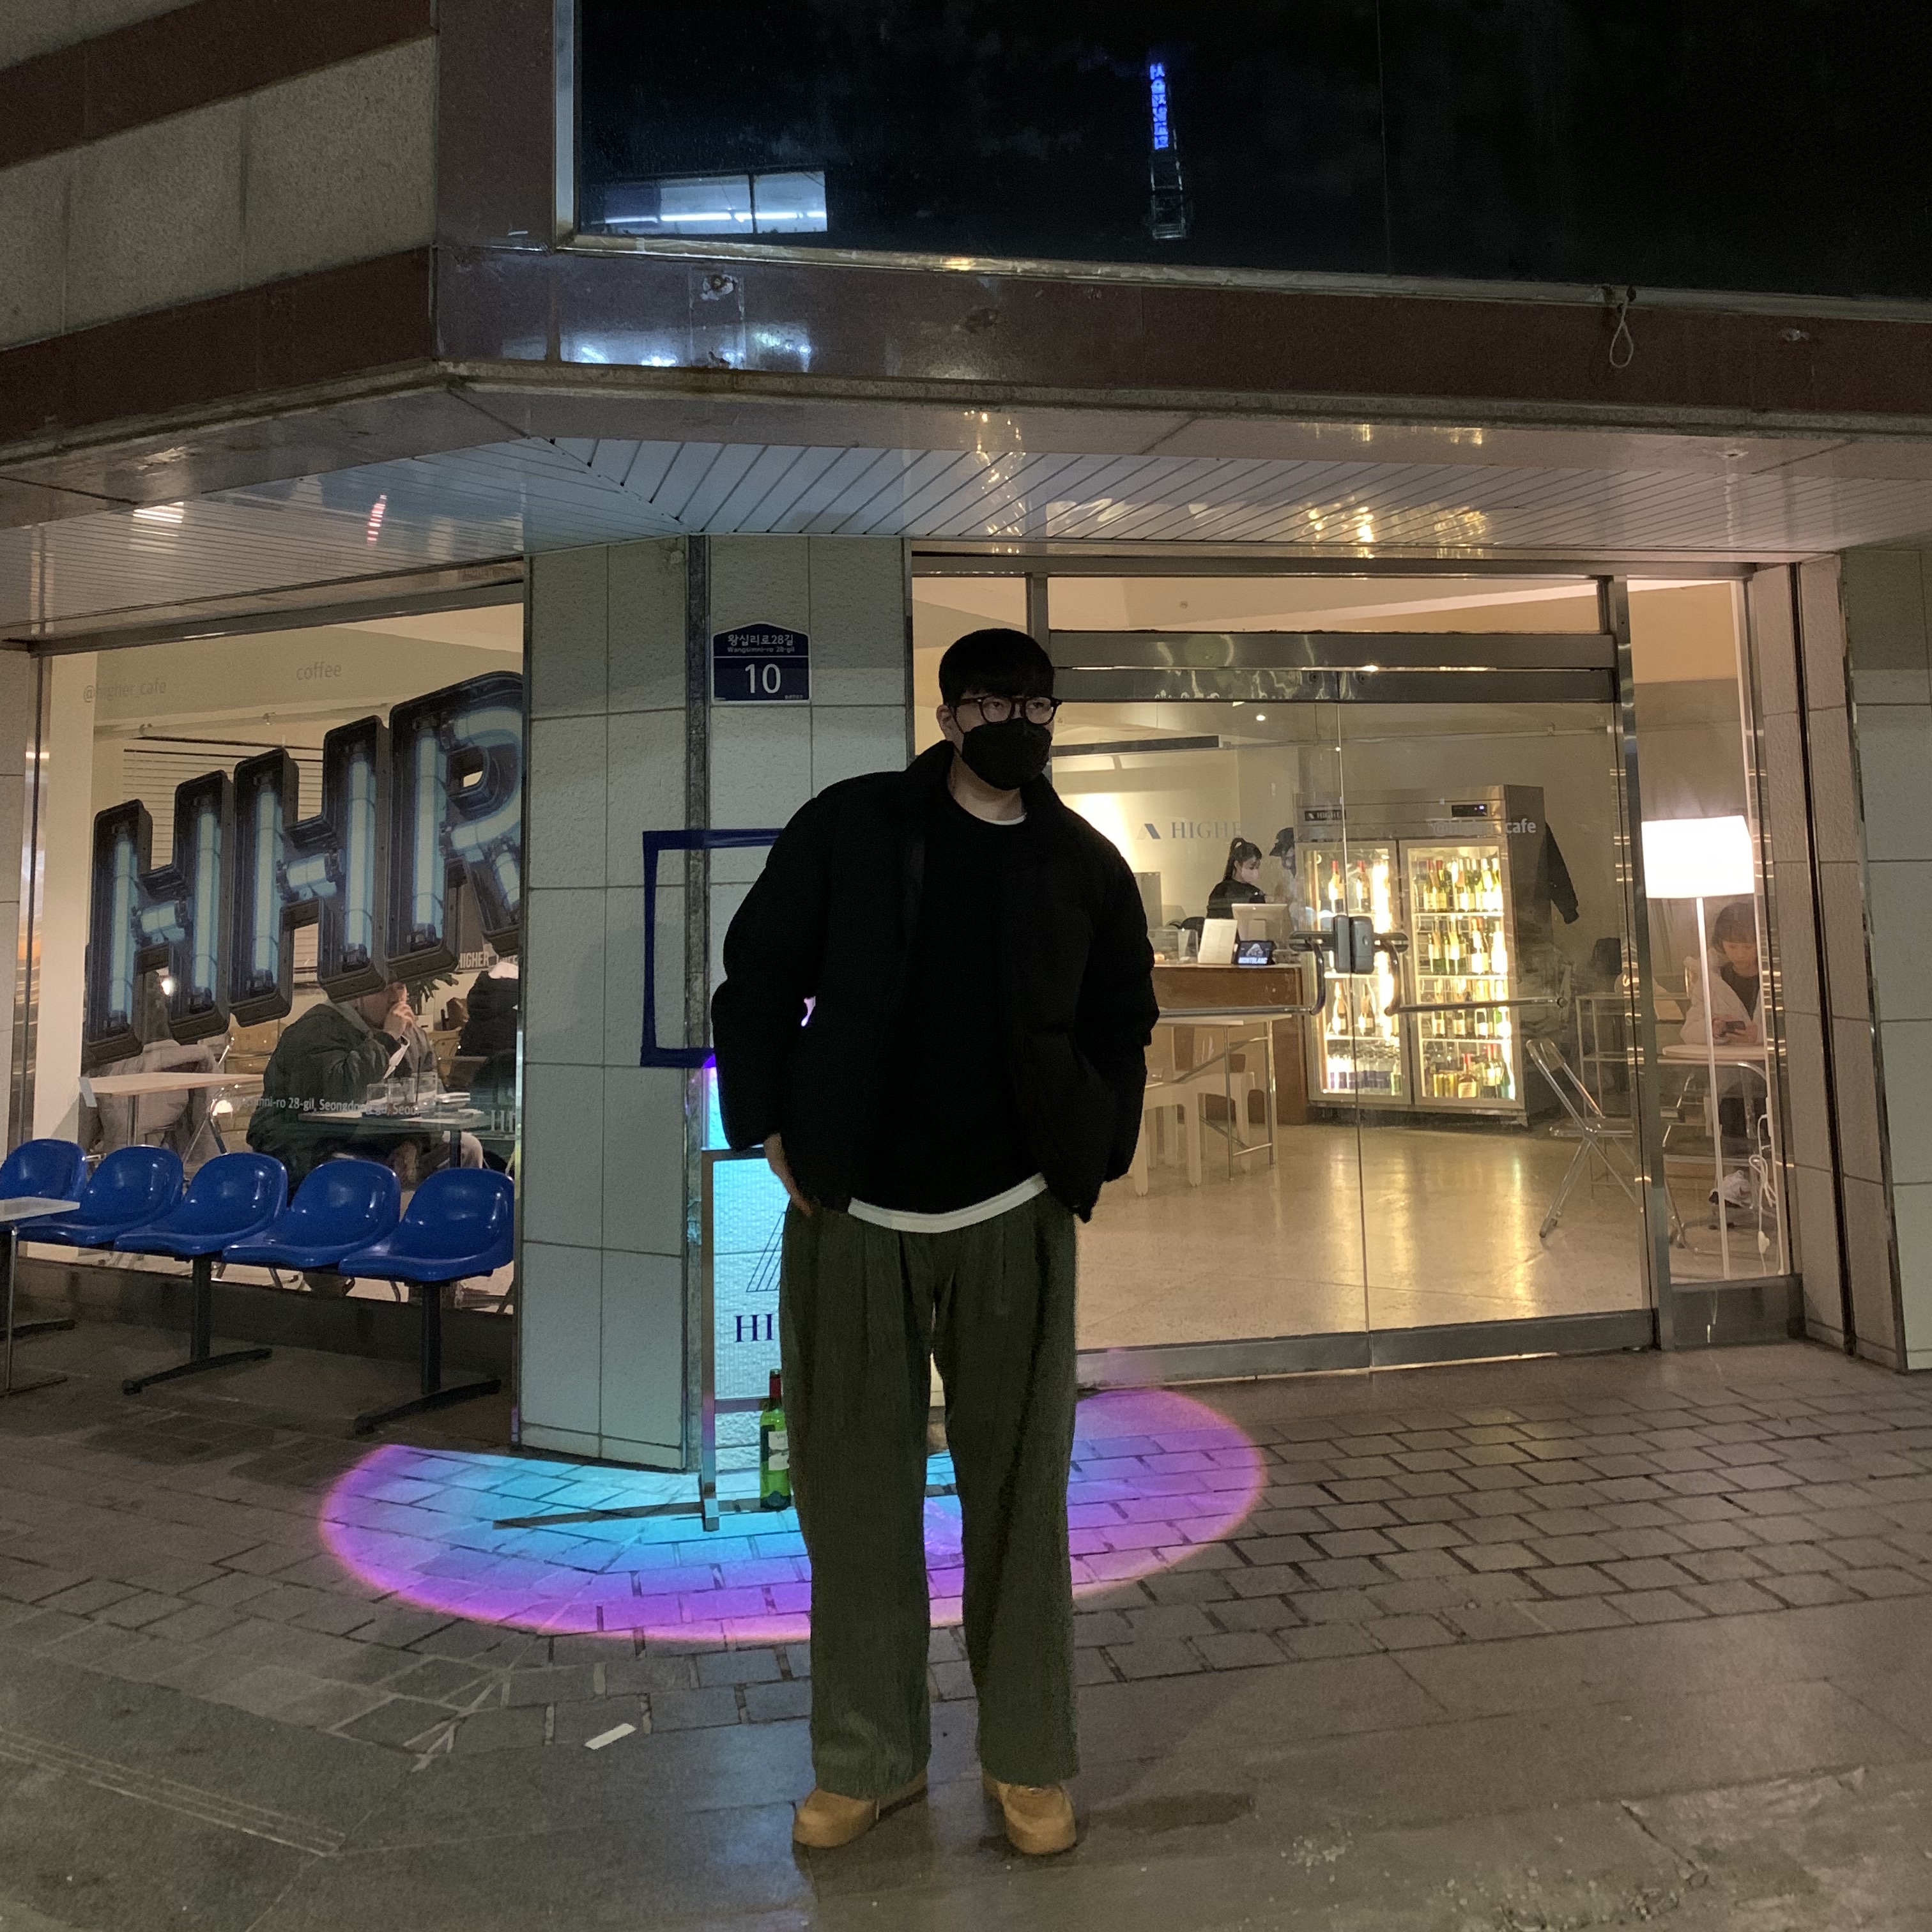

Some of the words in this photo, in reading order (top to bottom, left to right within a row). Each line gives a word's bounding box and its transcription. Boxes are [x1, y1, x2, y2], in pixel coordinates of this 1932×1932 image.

[727, 634, 793, 647] 왕십리로28길
[296, 661, 342, 680] coffee
[745, 664, 781, 694] 10
